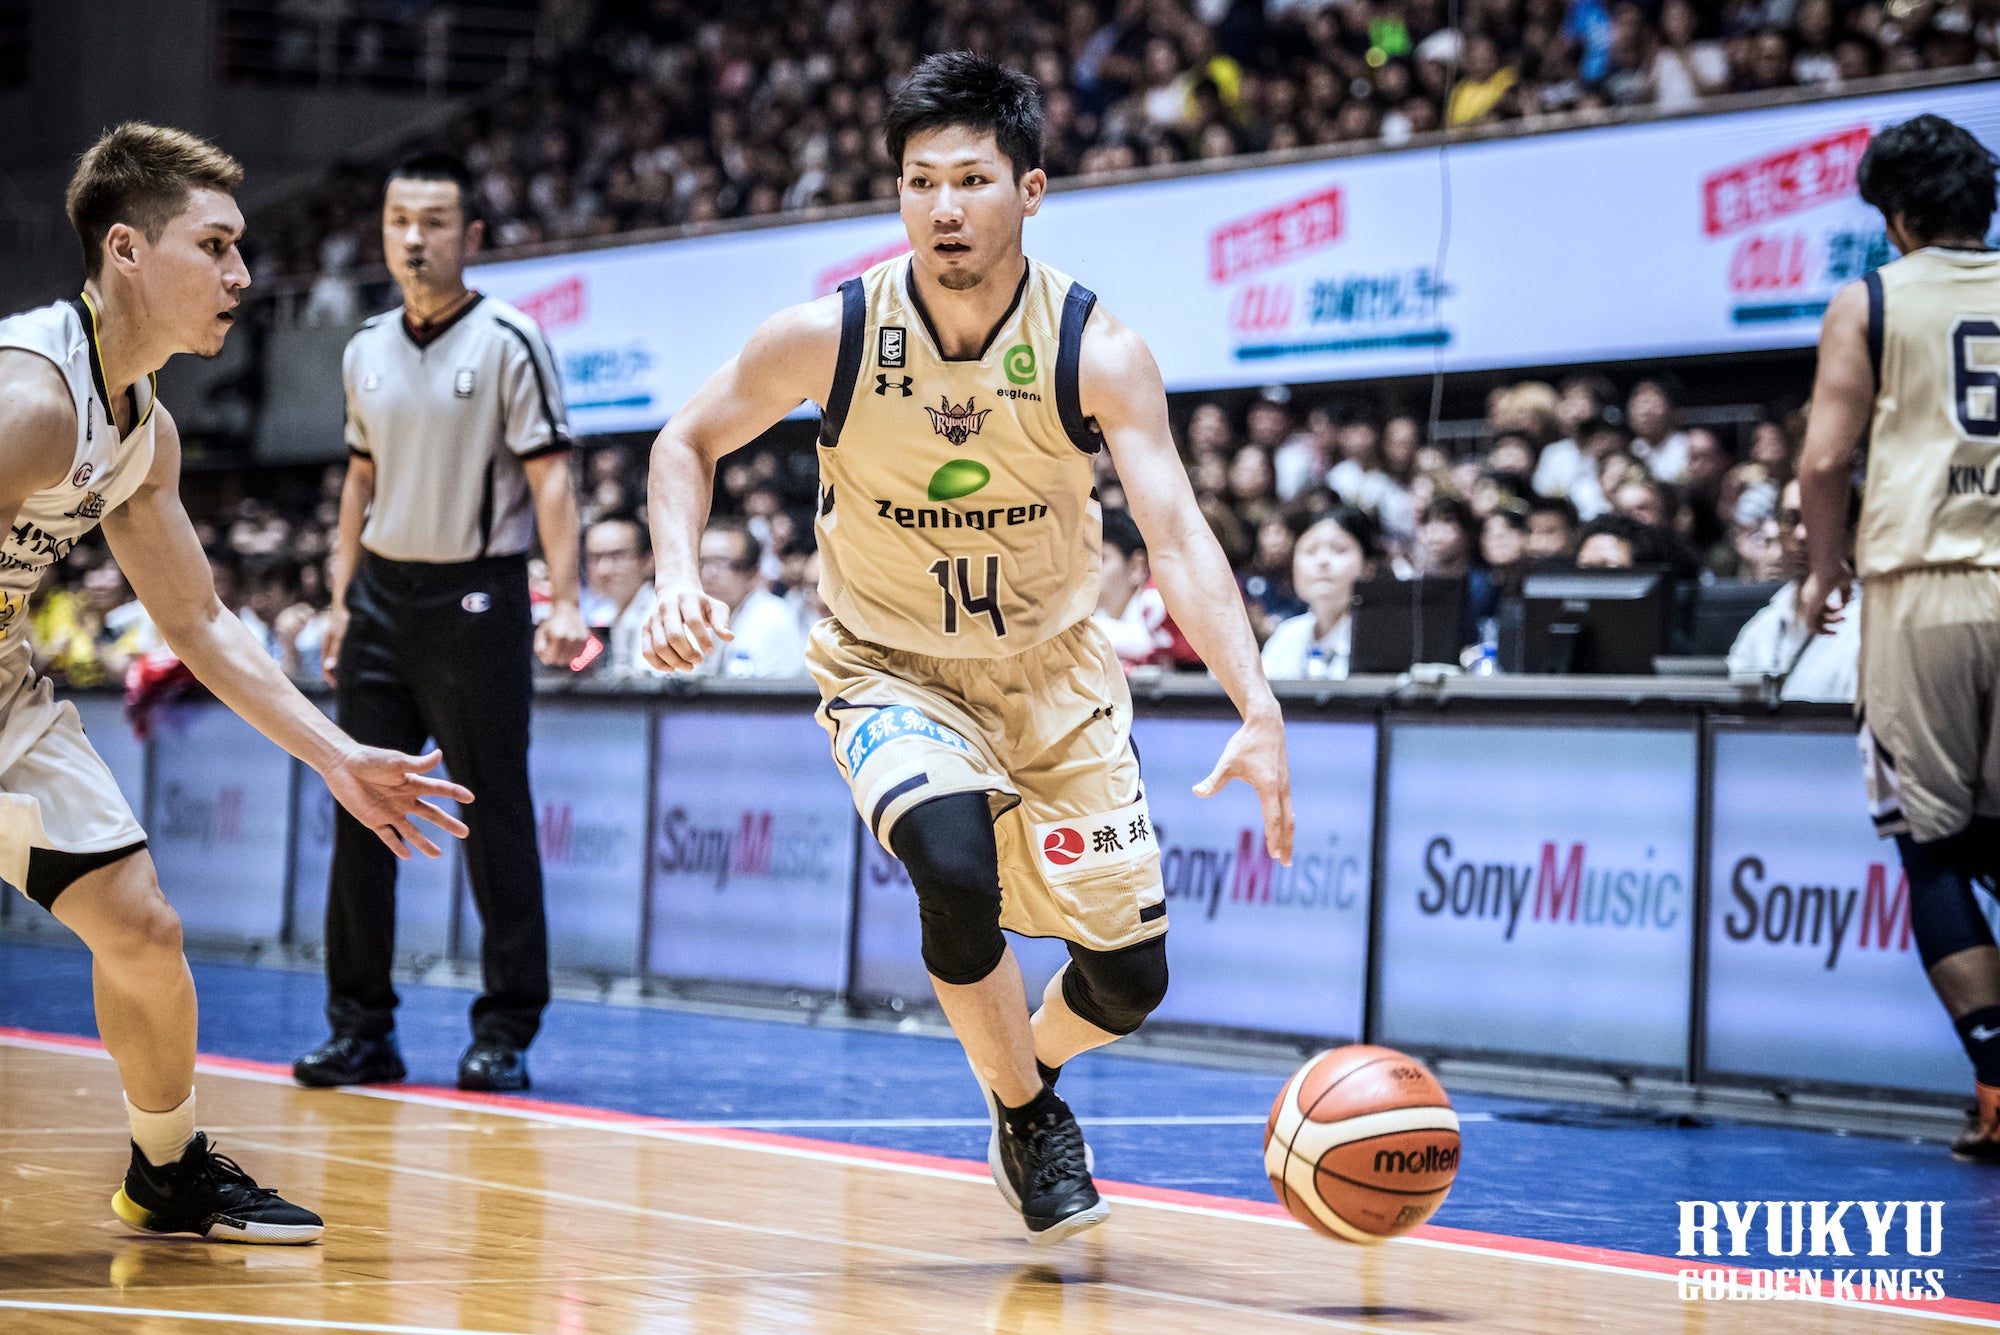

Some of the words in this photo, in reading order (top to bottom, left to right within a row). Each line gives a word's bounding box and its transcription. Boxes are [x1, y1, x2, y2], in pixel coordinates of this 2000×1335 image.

[1946, 313, 2000, 443] 6
[927, 554, 1008, 640] 14
[1092, 813, 1152, 854] 琉球
[1374, 1145, 1460, 1174] molten
